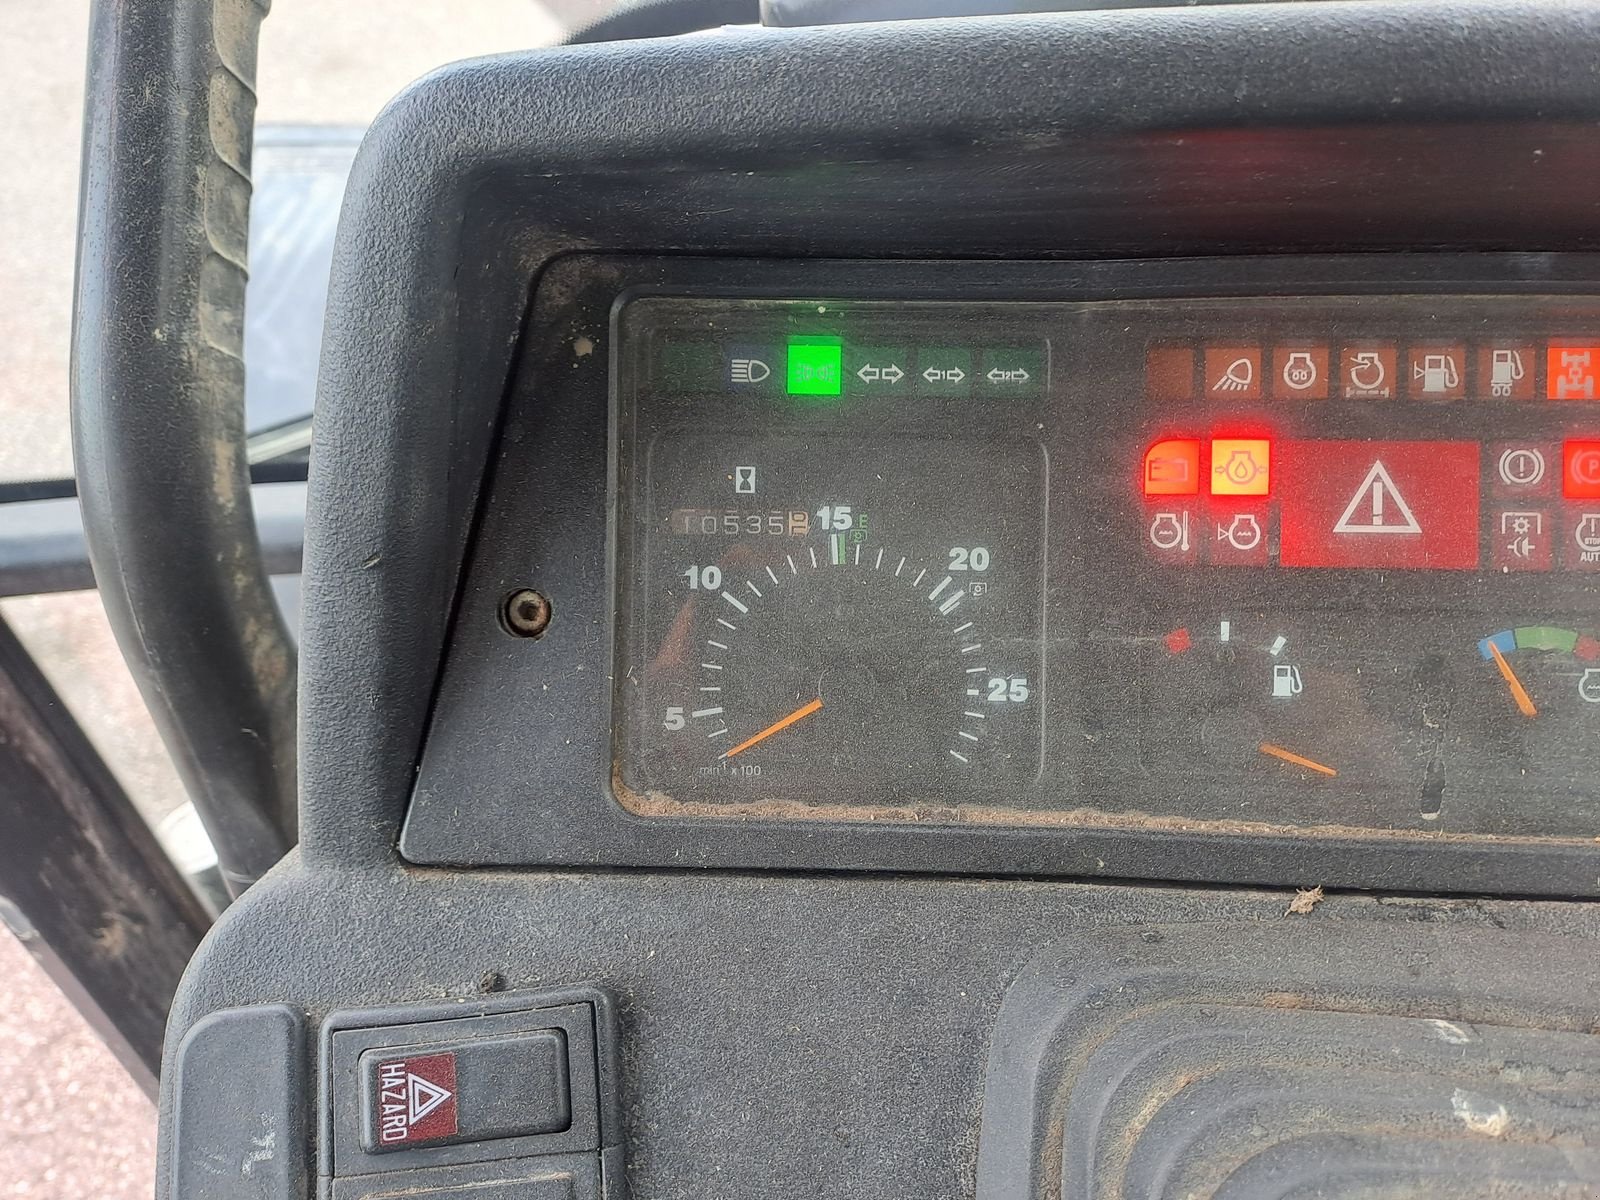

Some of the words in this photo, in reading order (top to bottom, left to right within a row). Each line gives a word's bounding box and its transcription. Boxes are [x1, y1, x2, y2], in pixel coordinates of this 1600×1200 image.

[817, 505, 853, 530] 15
[948, 547, 990, 571] 20
[683, 565, 722, 590] 10
[987, 678, 1029, 702] 25
[664, 706, 686, 731] 5
[381, 1063, 407, 1141] HAZARD
